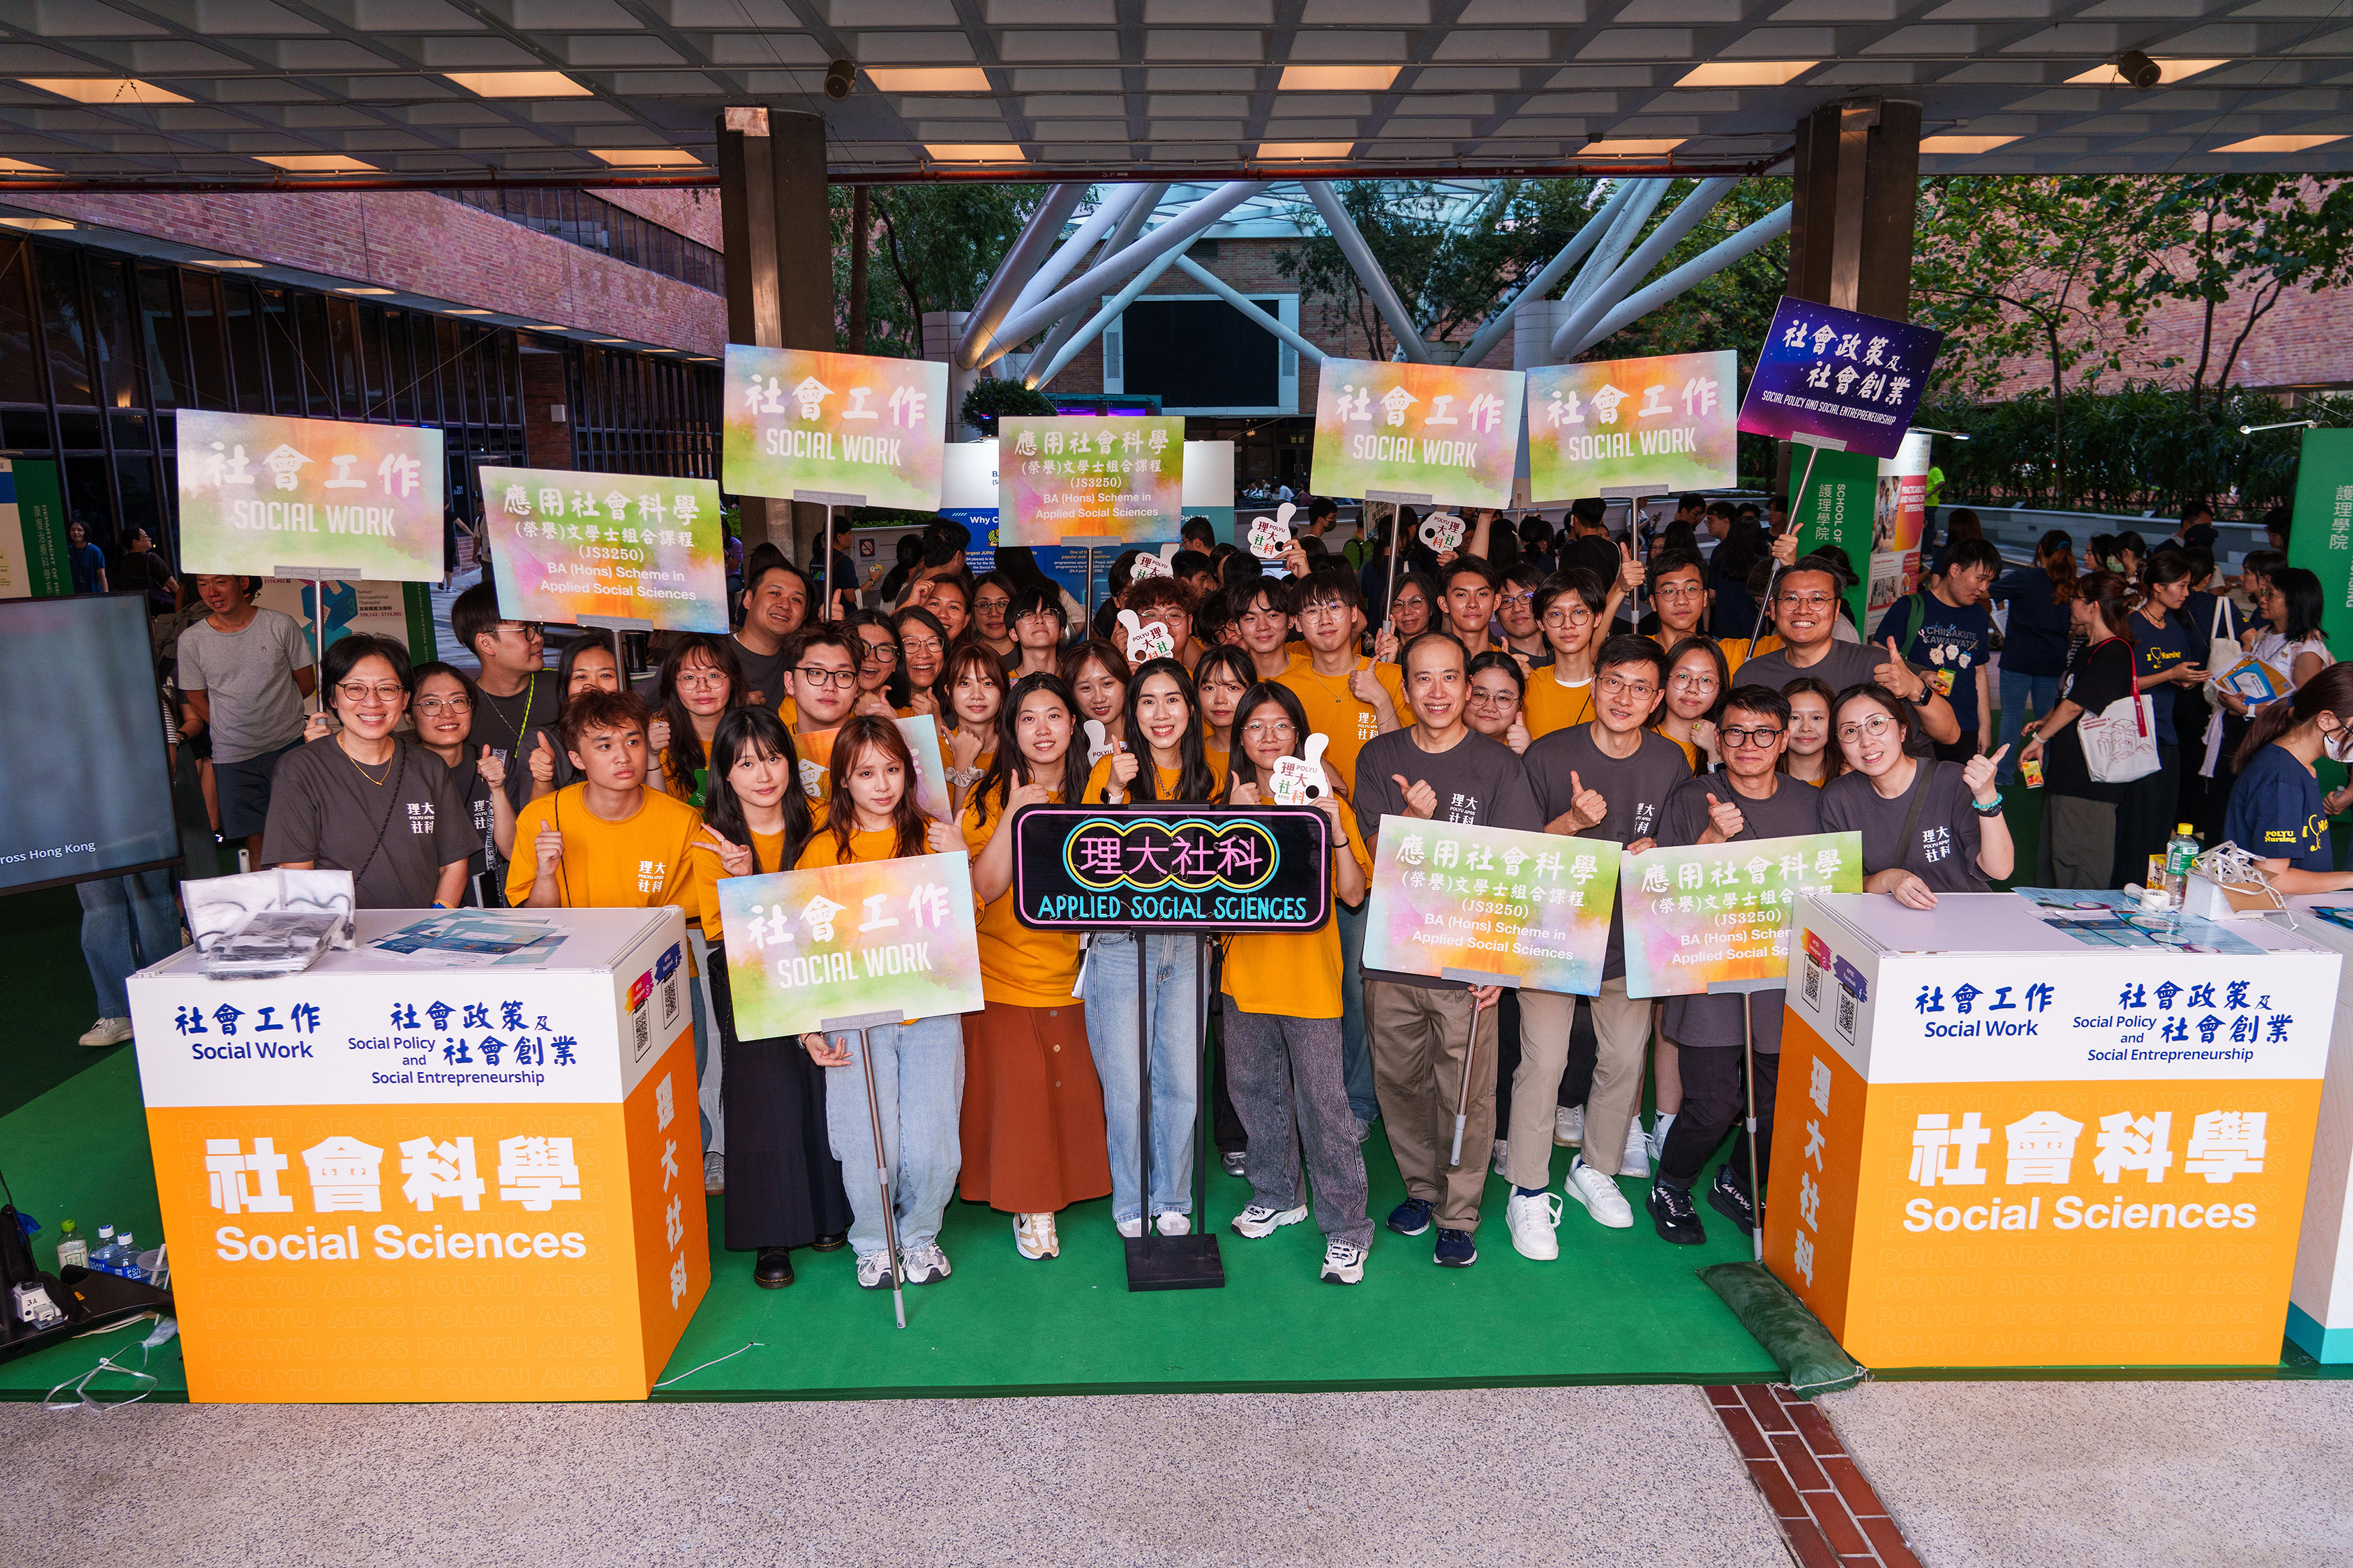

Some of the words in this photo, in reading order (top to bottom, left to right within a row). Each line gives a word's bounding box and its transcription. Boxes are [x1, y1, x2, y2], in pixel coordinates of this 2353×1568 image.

[1782, 319, 1901, 372] 社會政策及
[1806, 361, 1911, 405] 社會創業
[745, 374, 928, 429] 社會工作
[1336, 384, 1505, 434] 社會工作
[1547, 376, 1719, 429] 社會工作
[1761, 390, 1783, 404] SOCIAL
[1784, 395, 1805, 408] POLICY
[1805, 398, 1819, 411] AND
[1818, 401, 1839, 415] SOCIAL
[1839, 405, 1897, 426] ENTREPRENEURSHIP
[766, 428, 836, 462] SOCIAL
[842, 434, 902, 467] WORK
[1014, 429, 1169, 456] 應用社會科學
[1353, 434, 1417, 464] SOCIAL
[1422, 439, 1477, 468] WORK
[1568, 431, 1634, 462] SOCIAL
[1639, 427, 1697, 456] WORK
[204, 441, 422, 498] 社會工作
[1022, 459, 1162, 475] (榮譽)文學士組合課程
[1070, 477, 1121, 489] (JS3250)
[504, 484, 700, 526] 應用社會科學
[1043, 494, 1058, 503] BA
[1062, 493, 1094, 504] (Hons)
[1098, 493, 1139, 502] Scheme
[1815, 483, 1833, 540] 護理學院
[1834, 483, 1846, 526] SCHOOL
[234, 499, 319, 533] SOCIAL
[326, 505, 396, 536] WORK
[970, 516, 986, 526] Why
[1036, 509, 1075, 520] Applied
[1078, 508, 1109, 518] Social
[1112, 508, 1158, 517] Sciences
[1433, 516, 1450, 525] POLYU
[2329, 485, 2353, 550] 護理學院
[516, 522, 695, 548] (榮譽)文學士組合課程
[1269, 524, 1285, 533] POLYU
[1833, 529, 1843, 543] OF
[42, 505, 55, 565] DEPARTMENT
[52, 567, 58, 582] OF
[579, 545, 644, 563] (JS3250)
[548, 563, 567, 574] BA
[571, 564, 612, 579] (Hons)
[616, 567, 669, 581] Scheme
[1152, 560, 1168, 569] POLYU
[541, 580, 590, 594] Applied
[593, 584, 634, 597] Social
[637, 586, 696, 600] Sciences
[1132, 631, 1150, 643] POLYU
[1926, 626, 1977, 641] CHIISAKUTE
[2161, 651, 2182, 660] Nursing
[1296, 765, 1318, 774] POLYU
[29, 848, 63, 860] Hong
[65, 842, 96, 854] Kong
[1080, 835, 1263, 877] 理大社科
[1395, 834, 1598, 886] 應用社會科學
[1641, 848, 1842, 893] 應用社會科學
[1402, 870, 1585, 907] (榮譽)文學士組合課程
[747, 882, 950, 950] 社會工作
[1037, 895, 1121, 919] APPLIED
[1130, 896, 1207, 919] SOCIAL
[1213, 897, 1306, 920] SCIENCES
[1462, 897, 1529, 919] (JS3250)
[1714, 909, 1782, 927] (JS3250)
[1425, 913, 1444, 926] BA
[1448, 916, 1491, 934] (Hons)
[1494, 922, 1550, 939] Scheme
[1681, 934, 1699, 947] BA
[1704, 931, 1747, 946] (Hons)
[1412, 931, 1464, 948] Applied
[1467, 938, 1509, 952] Social
[1512, 943, 1573, 960] Sciences
[1672, 952, 1722, 964] Applied
[1726, 947, 1767, 959] Social
[777, 950, 859, 989] SOCIAL
[863, 941, 932, 978] WORK
[1914, 982, 2055, 1015] 社會工作
[2118, 980, 2272, 1011] 社會政策及
[174, 1002, 321, 1036] 社會工作
[391, 1000, 553, 1032] 社會政策及
[1924, 1020, 1980, 1038] Social
[1985, 1020, 2039, 1037] Work
[2073, 1016, 2114, 1028] Social
[2116, 1016, 2157, 1030] Policy
[2161, 1014, 2294, 1044] 社會創業
[192, 1042, 251, 1060] Social
[253, 1041, 314, 1059] Work
[348, 1036, 391, 1050] Social
[394, 1037, 436, 1052] Policy
[442, 1035, 577, 1067] 社會創業
[2120, 1032, 2144, 1044] and
[402, 1055, 426, 1066] and
[2087, 1049, 2127, 1061] Social
[2130, 1048, 2254, 1063] Entrepreneurship
[371, 1071, 413, 1084] Social
[417, 1070, 545, 1087] Entrepreneurship
[1908, 1109, 2268, 1186] 社會科學
[205, 1136, 582, 1214] 社會科學
[1903, 1196, 2040, 1232] Social
[2052, 1196, 2258, 1229] Sciences
[215, 1225, 360, 1262] Social
[373, 1224, 587, 1260] Sciences
[27, 1298, 38, 1307] 3A
[1872, 1306, 1978, 1328] POLYU
[1986, 1305, 2062, 1325] APSS
[2071, 1304, 2178, 1324] POLYU
[2186, 1303, 2262, 1323] APSS
